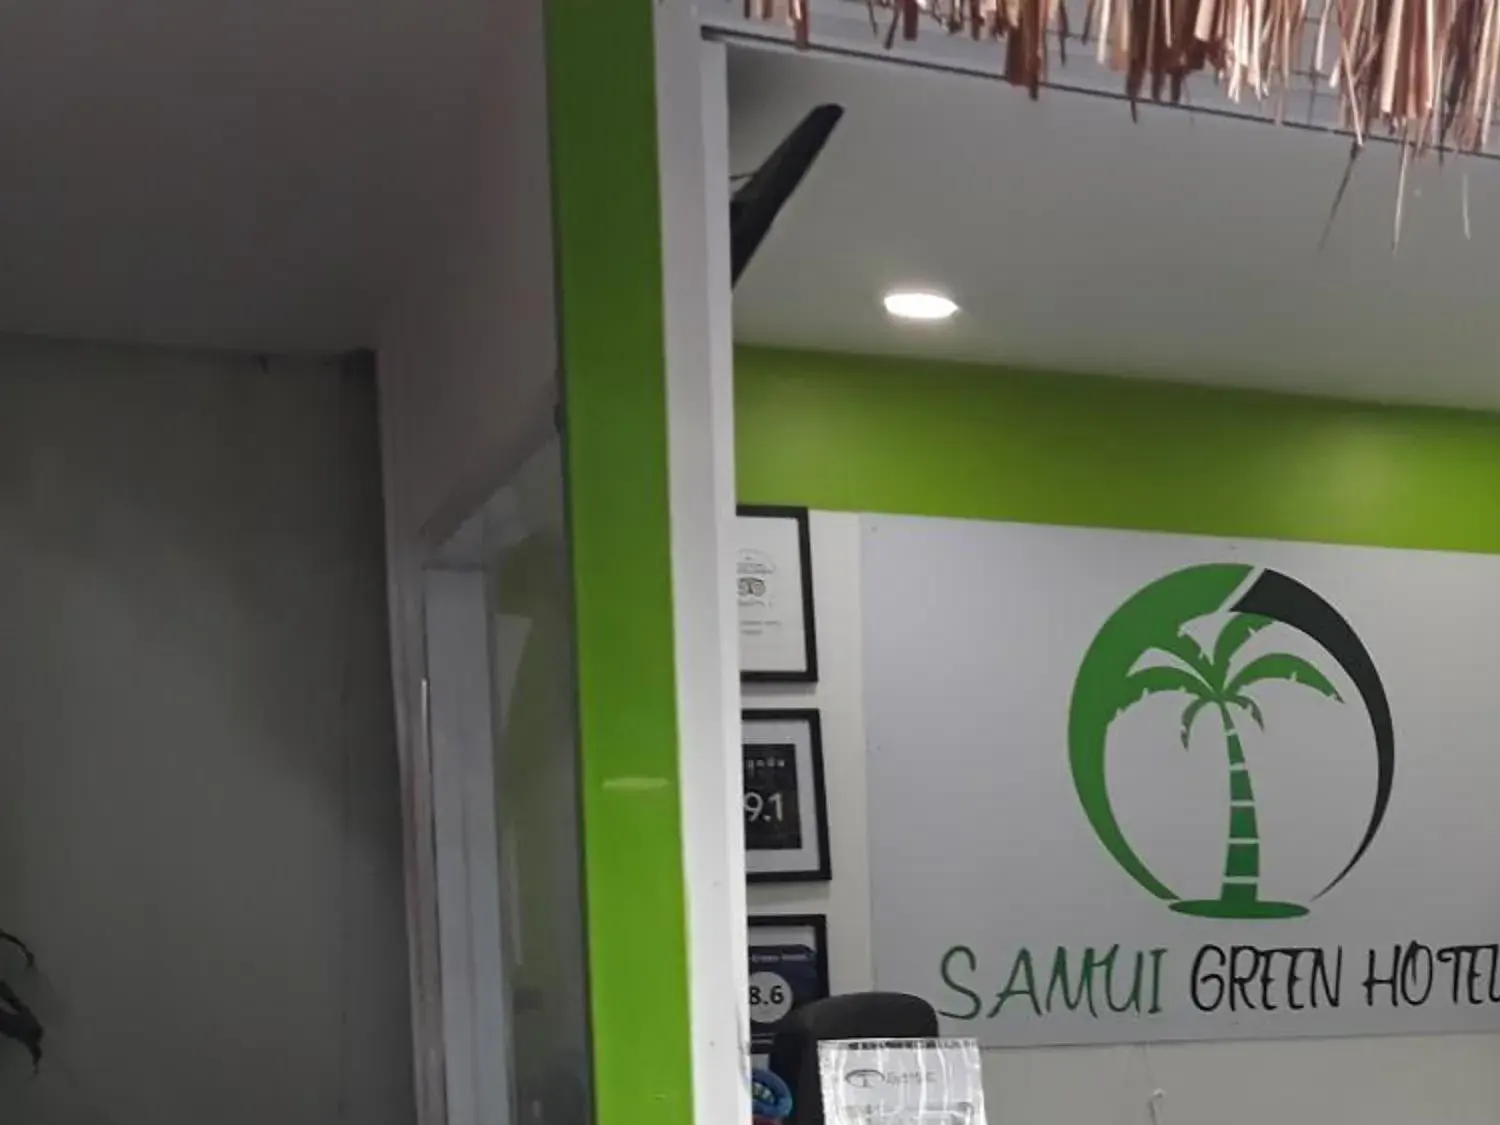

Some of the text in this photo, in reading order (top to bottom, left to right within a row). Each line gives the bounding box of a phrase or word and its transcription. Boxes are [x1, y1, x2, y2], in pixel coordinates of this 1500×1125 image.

[744, 792, 783, 822] 9.1
[750, 985, 785, 1005] 8.6
[938, 943, 1168, 1020] SAMUI
[1190, 944, 1343, 1012] GREEN
